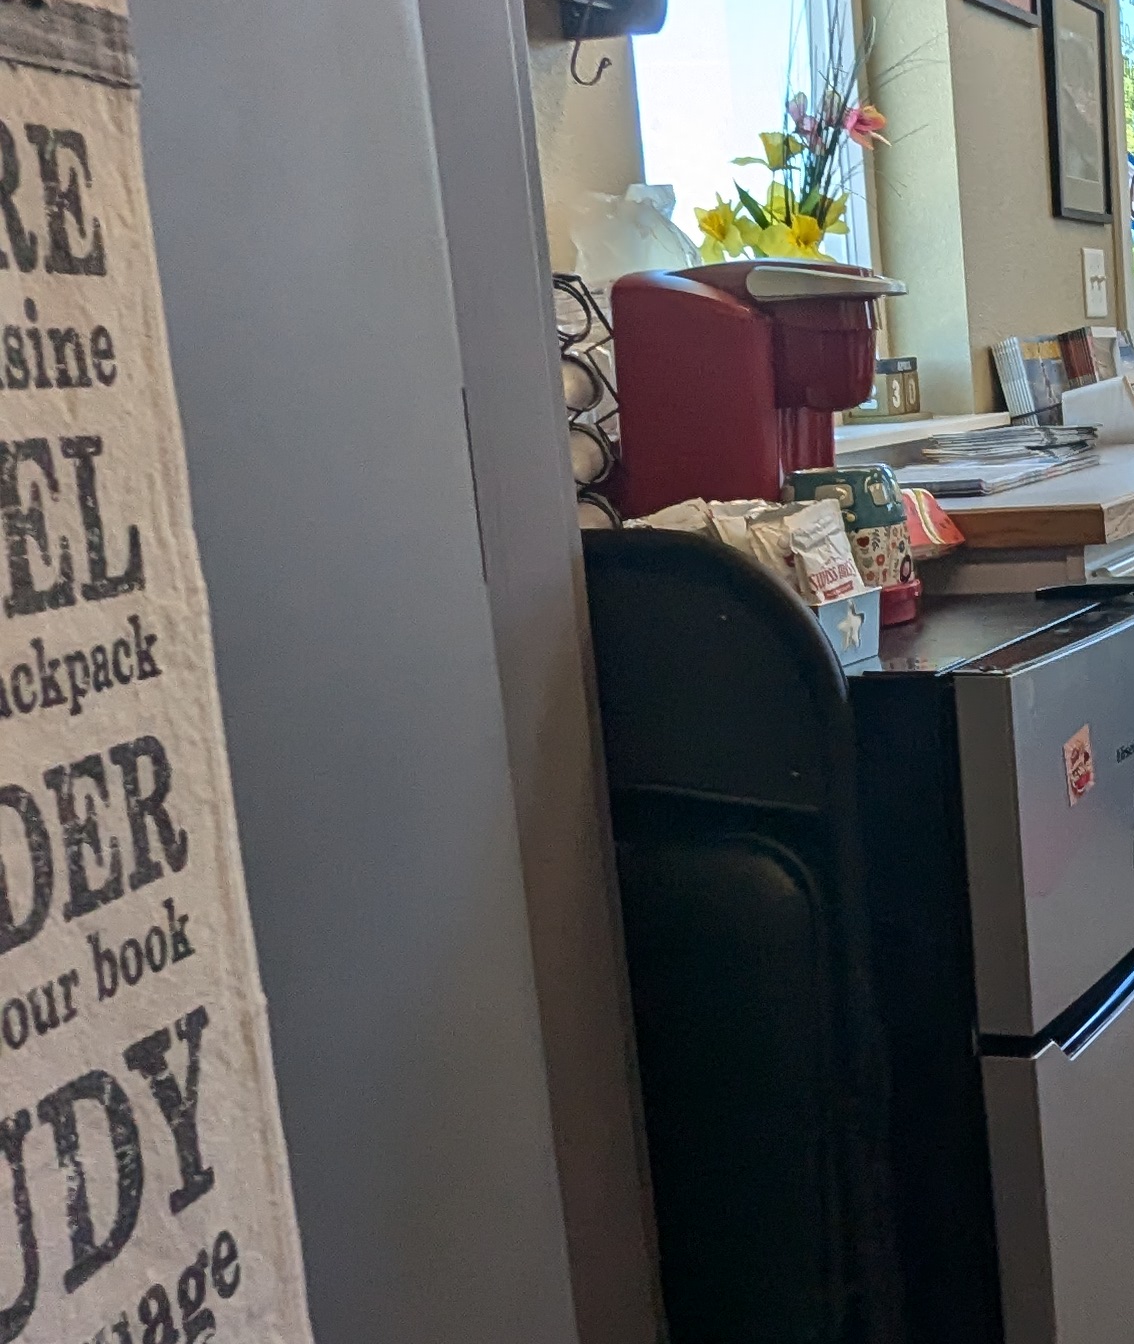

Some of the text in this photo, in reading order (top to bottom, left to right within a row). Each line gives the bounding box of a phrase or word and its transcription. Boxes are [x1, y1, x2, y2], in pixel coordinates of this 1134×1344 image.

[0, 297, 117, 390] sine
[2, 897, 196, 1050] our book
